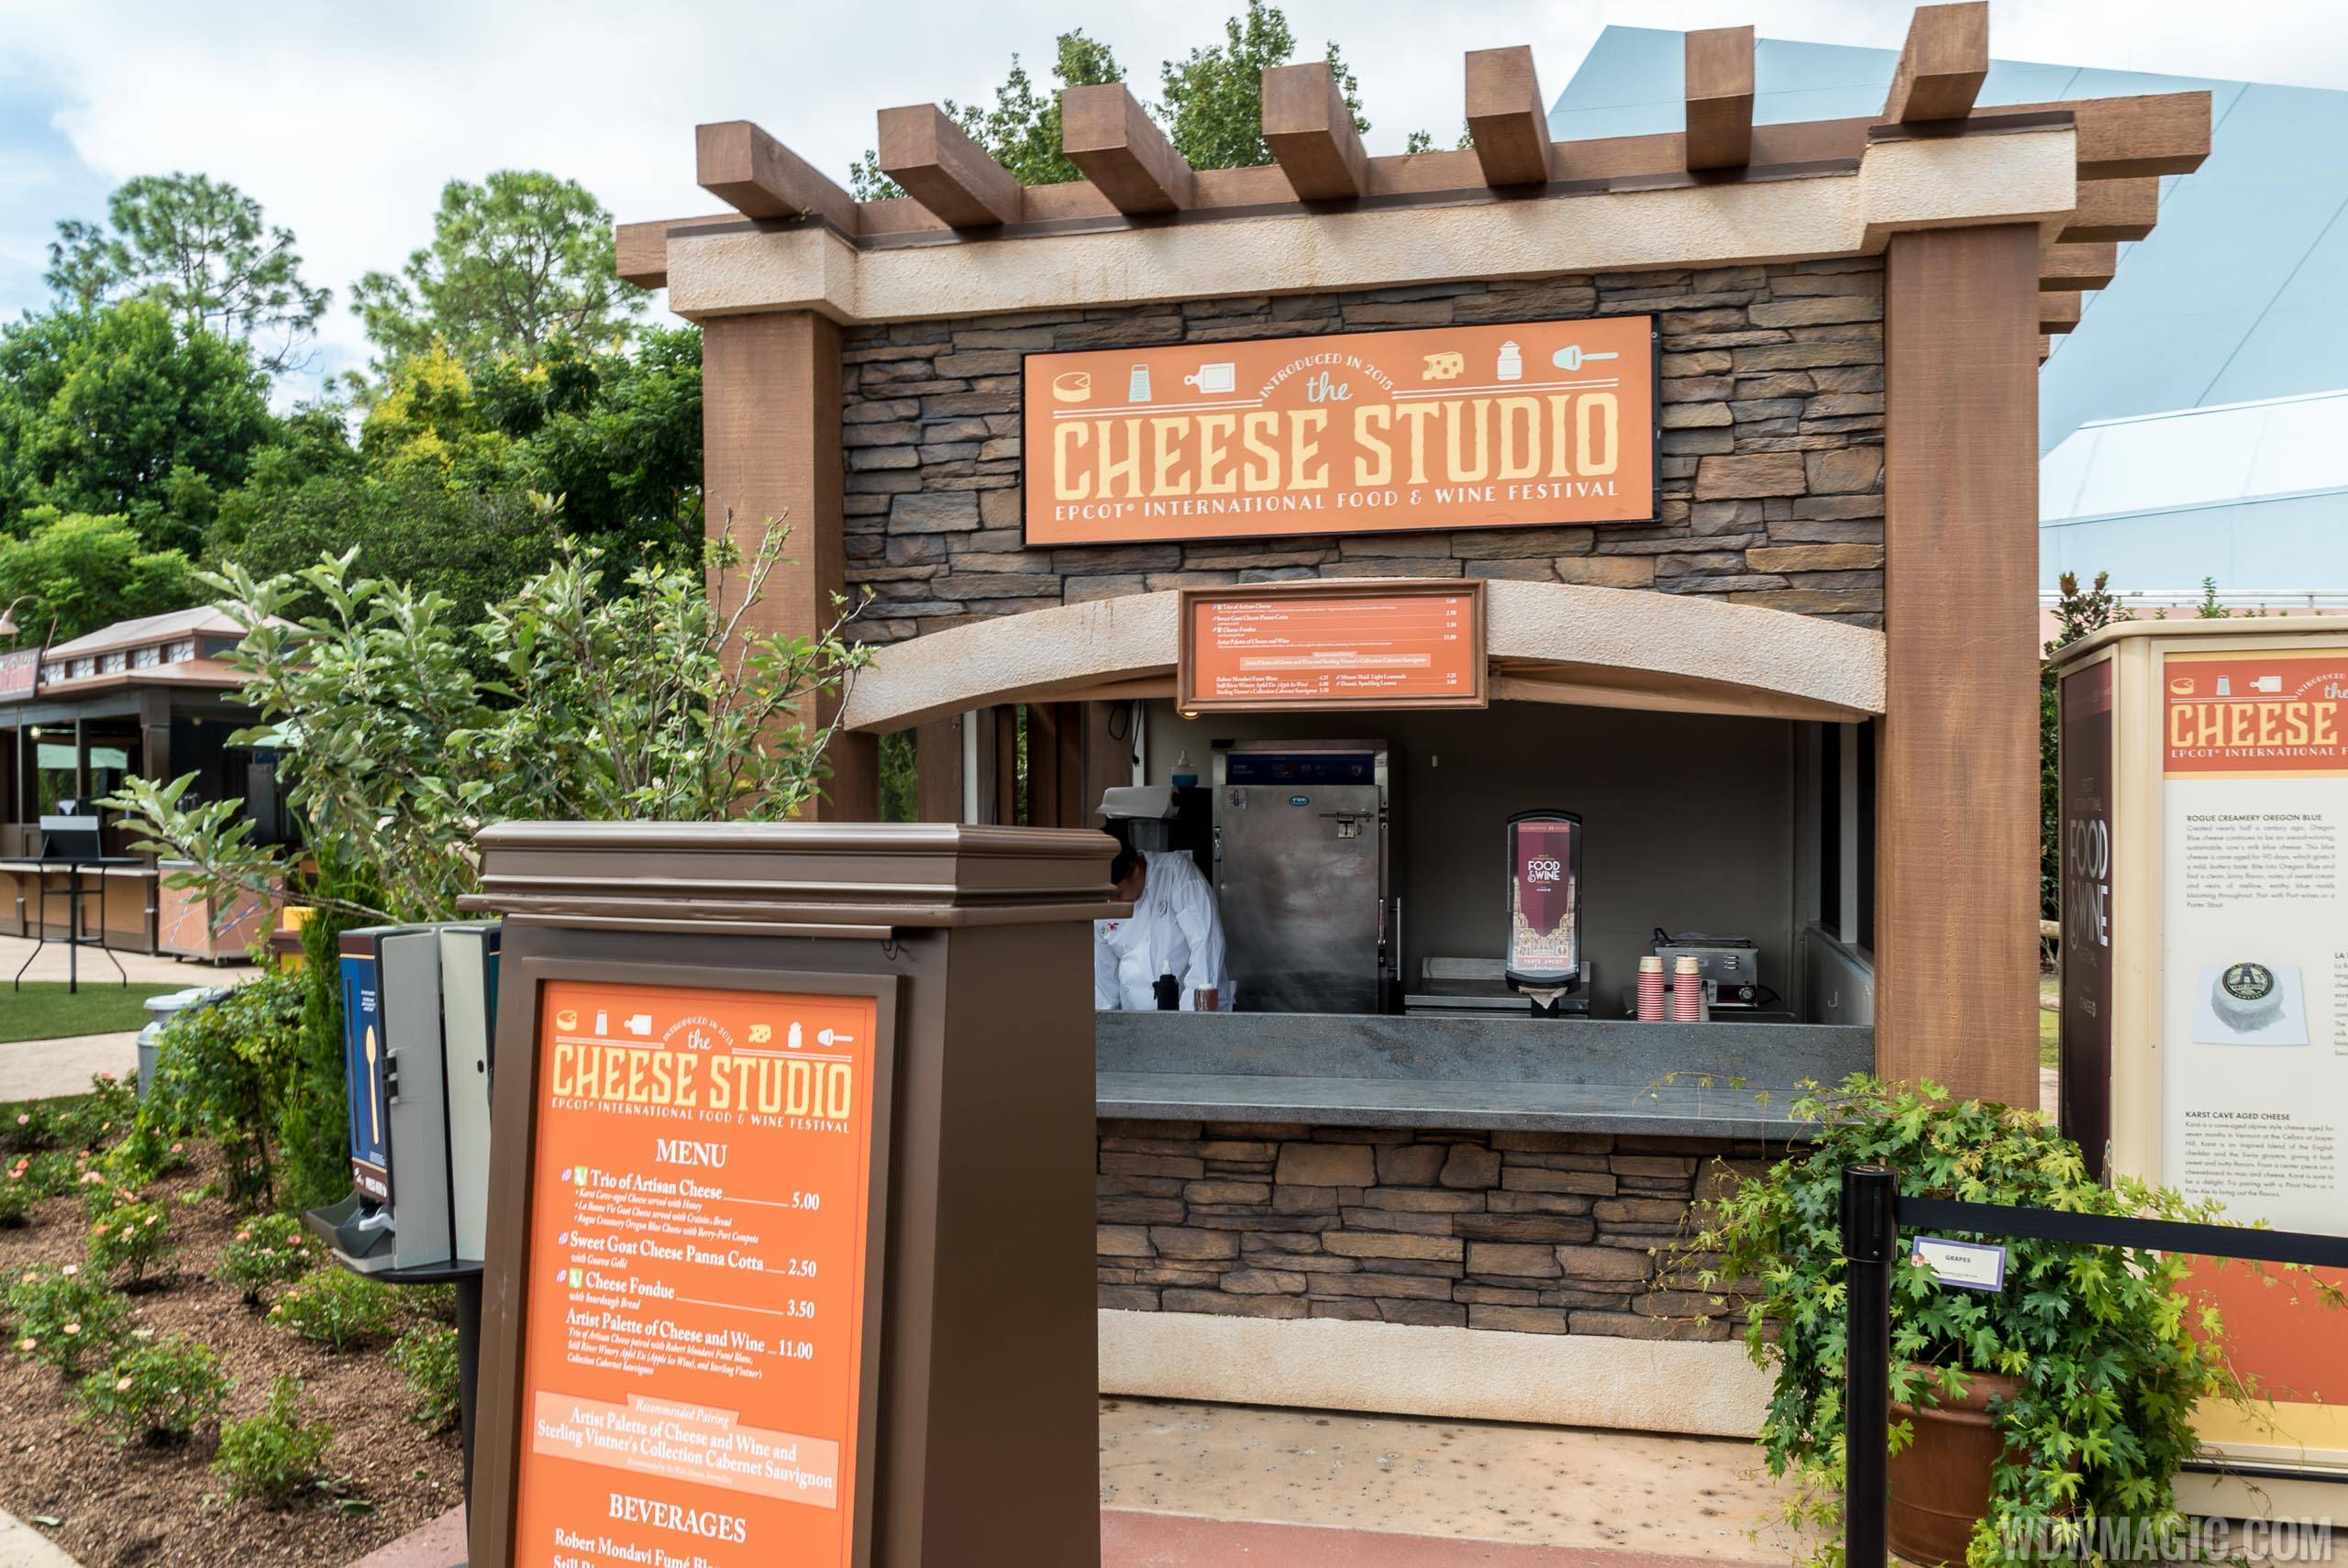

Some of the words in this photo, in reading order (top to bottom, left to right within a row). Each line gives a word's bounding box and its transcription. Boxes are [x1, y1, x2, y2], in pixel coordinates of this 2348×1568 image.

[1258, 352, 1343, 399] INTRODUCED
[1346, 355, 1363, 370] IN
[1364, 363, 1394, 391] 2015
[1306, 370, 1354, 403] the
[1053, 408, 1329, 501] CHEESE
[1353, 393, 1620, 488] STUDIO
[1144, 494, 1325, 517] INTERNATIONAL
[1337, 491, 1398, 508] FOOD
[1410, 489, 1423, 505] &
[1434, 486, 1497, 504] WINE
[1508, 480, 1620, 501] FESTIVAL
[2170, 701, 2338, 747] CHEESE
[2225, 746, 2335, 757] INTERNATIONAL
[1528, 860, 1560, 871] FOOD
[2069, 819, 2109, 880] FOOD
[688, 1029, 712, 1050] the
[553, 1044, 697, 1106] CHEESE
[710, 1055, 851, 1118] STUDIO
[598, 1101, 692, 1120] INTERNATIONAL
[699, 1110, 732, 1122] FOOD
[737, 1113, 745, 1124] &
[751, 1114, 783, 1127] WINE
[790, 1118, 847, 1132] FESTIVAL
[657, 1139, 726, 1167] MENU
[591, 1169, 617, 1188] Trio
[618, 1173, 634, 1189] of
[633, 1175, 677, 1195] Artisan
[679, 1179, 723, 1199] Cheese
[792, 1192, 820, 1210] 5.00
[570, 1231, 604, 1251] Sweet
[606, 1235, 637, 1254] Goat
[639, 1240, 683, 1261] Cheese
[686, 1245, 725, 1266] Panna
[727, 1250, 764, 1271] Cotta
[788, 1258, 817, 1277] 2.50
[1944, 1254, 1971, 1264] GRAPES
[585, 1271, 627, 1292] Cheese
[630, 1276, 675, 1298] Fondue
[787, 1299, 815, 1319] 3.50
[566, 1308, 600, 1328] Artist
[602, 1312, 643, 1334] Palette
[644, 1320, 659, 1336] of
[659, 1320, 703, 1342] Cheese
[704, 1330, 728, 1347] and
[730, 1331, 765, 1353] Wine
[780, 1340, 814, 1359] 11.00
[570, 1408, 604, 1427] Artist
[606, 1412, 648, 1435] Palette
[649, 1421, 664, 1438] of
[664, 1423, 708, 1445] Cheese
[710, 1433, 734, 1451] and
[736, 1435, 770, 1457] Wine
[773, 1444, 797, 1462] and
[636, 1398, 695, 1419] Recommended
[696, 1408, 729, 1430] Pairing
[538, 1419, 583, 1448] Sterling
[585, 1428, 637, 1452] Vintner's
[640, 1438, 703, 1464] Collection
[705, 1450, 763, 1475] Cabernet
[765, 1460, 832, 1489] Sauvignon
[610, 1494, 746, 1542] BEVERAGES
[555, 1528, 595, 1551] Robert
[598, 1537, 652, 1563] Mondavi
